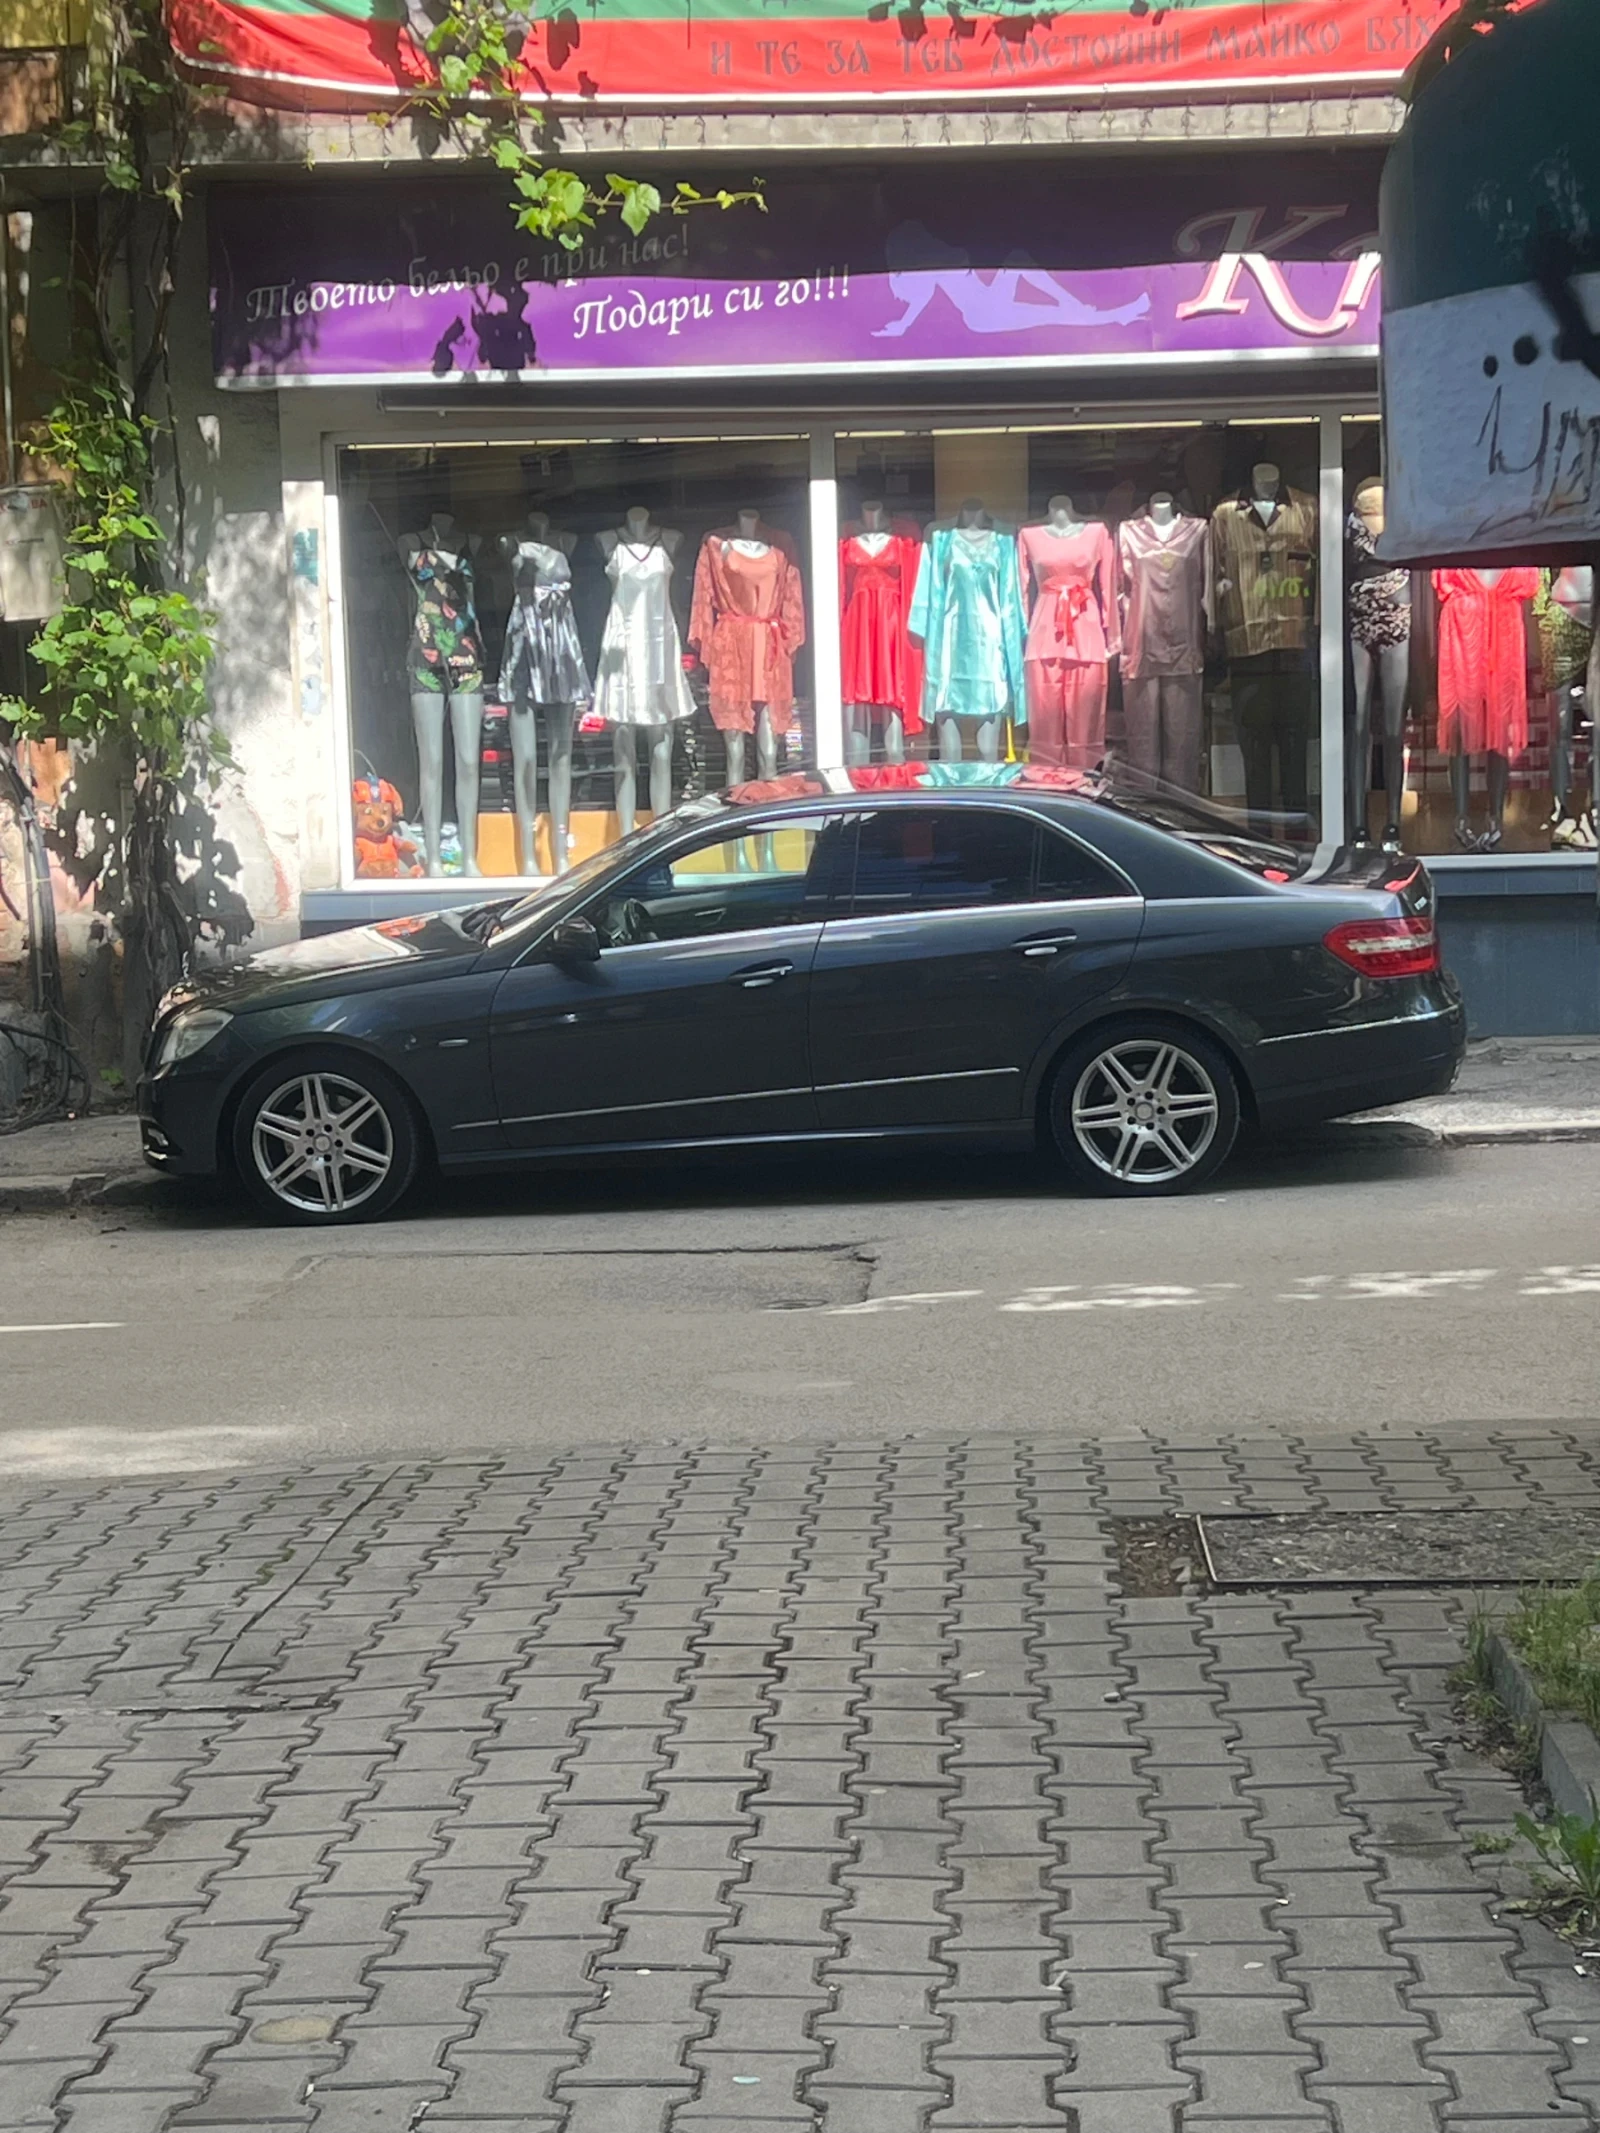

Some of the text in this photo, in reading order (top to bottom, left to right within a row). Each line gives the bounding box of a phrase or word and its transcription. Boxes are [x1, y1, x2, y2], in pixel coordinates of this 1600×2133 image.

[827, 39, 870, 74] ЗА
[573, 264, 850, 339] Подари си го!!!
